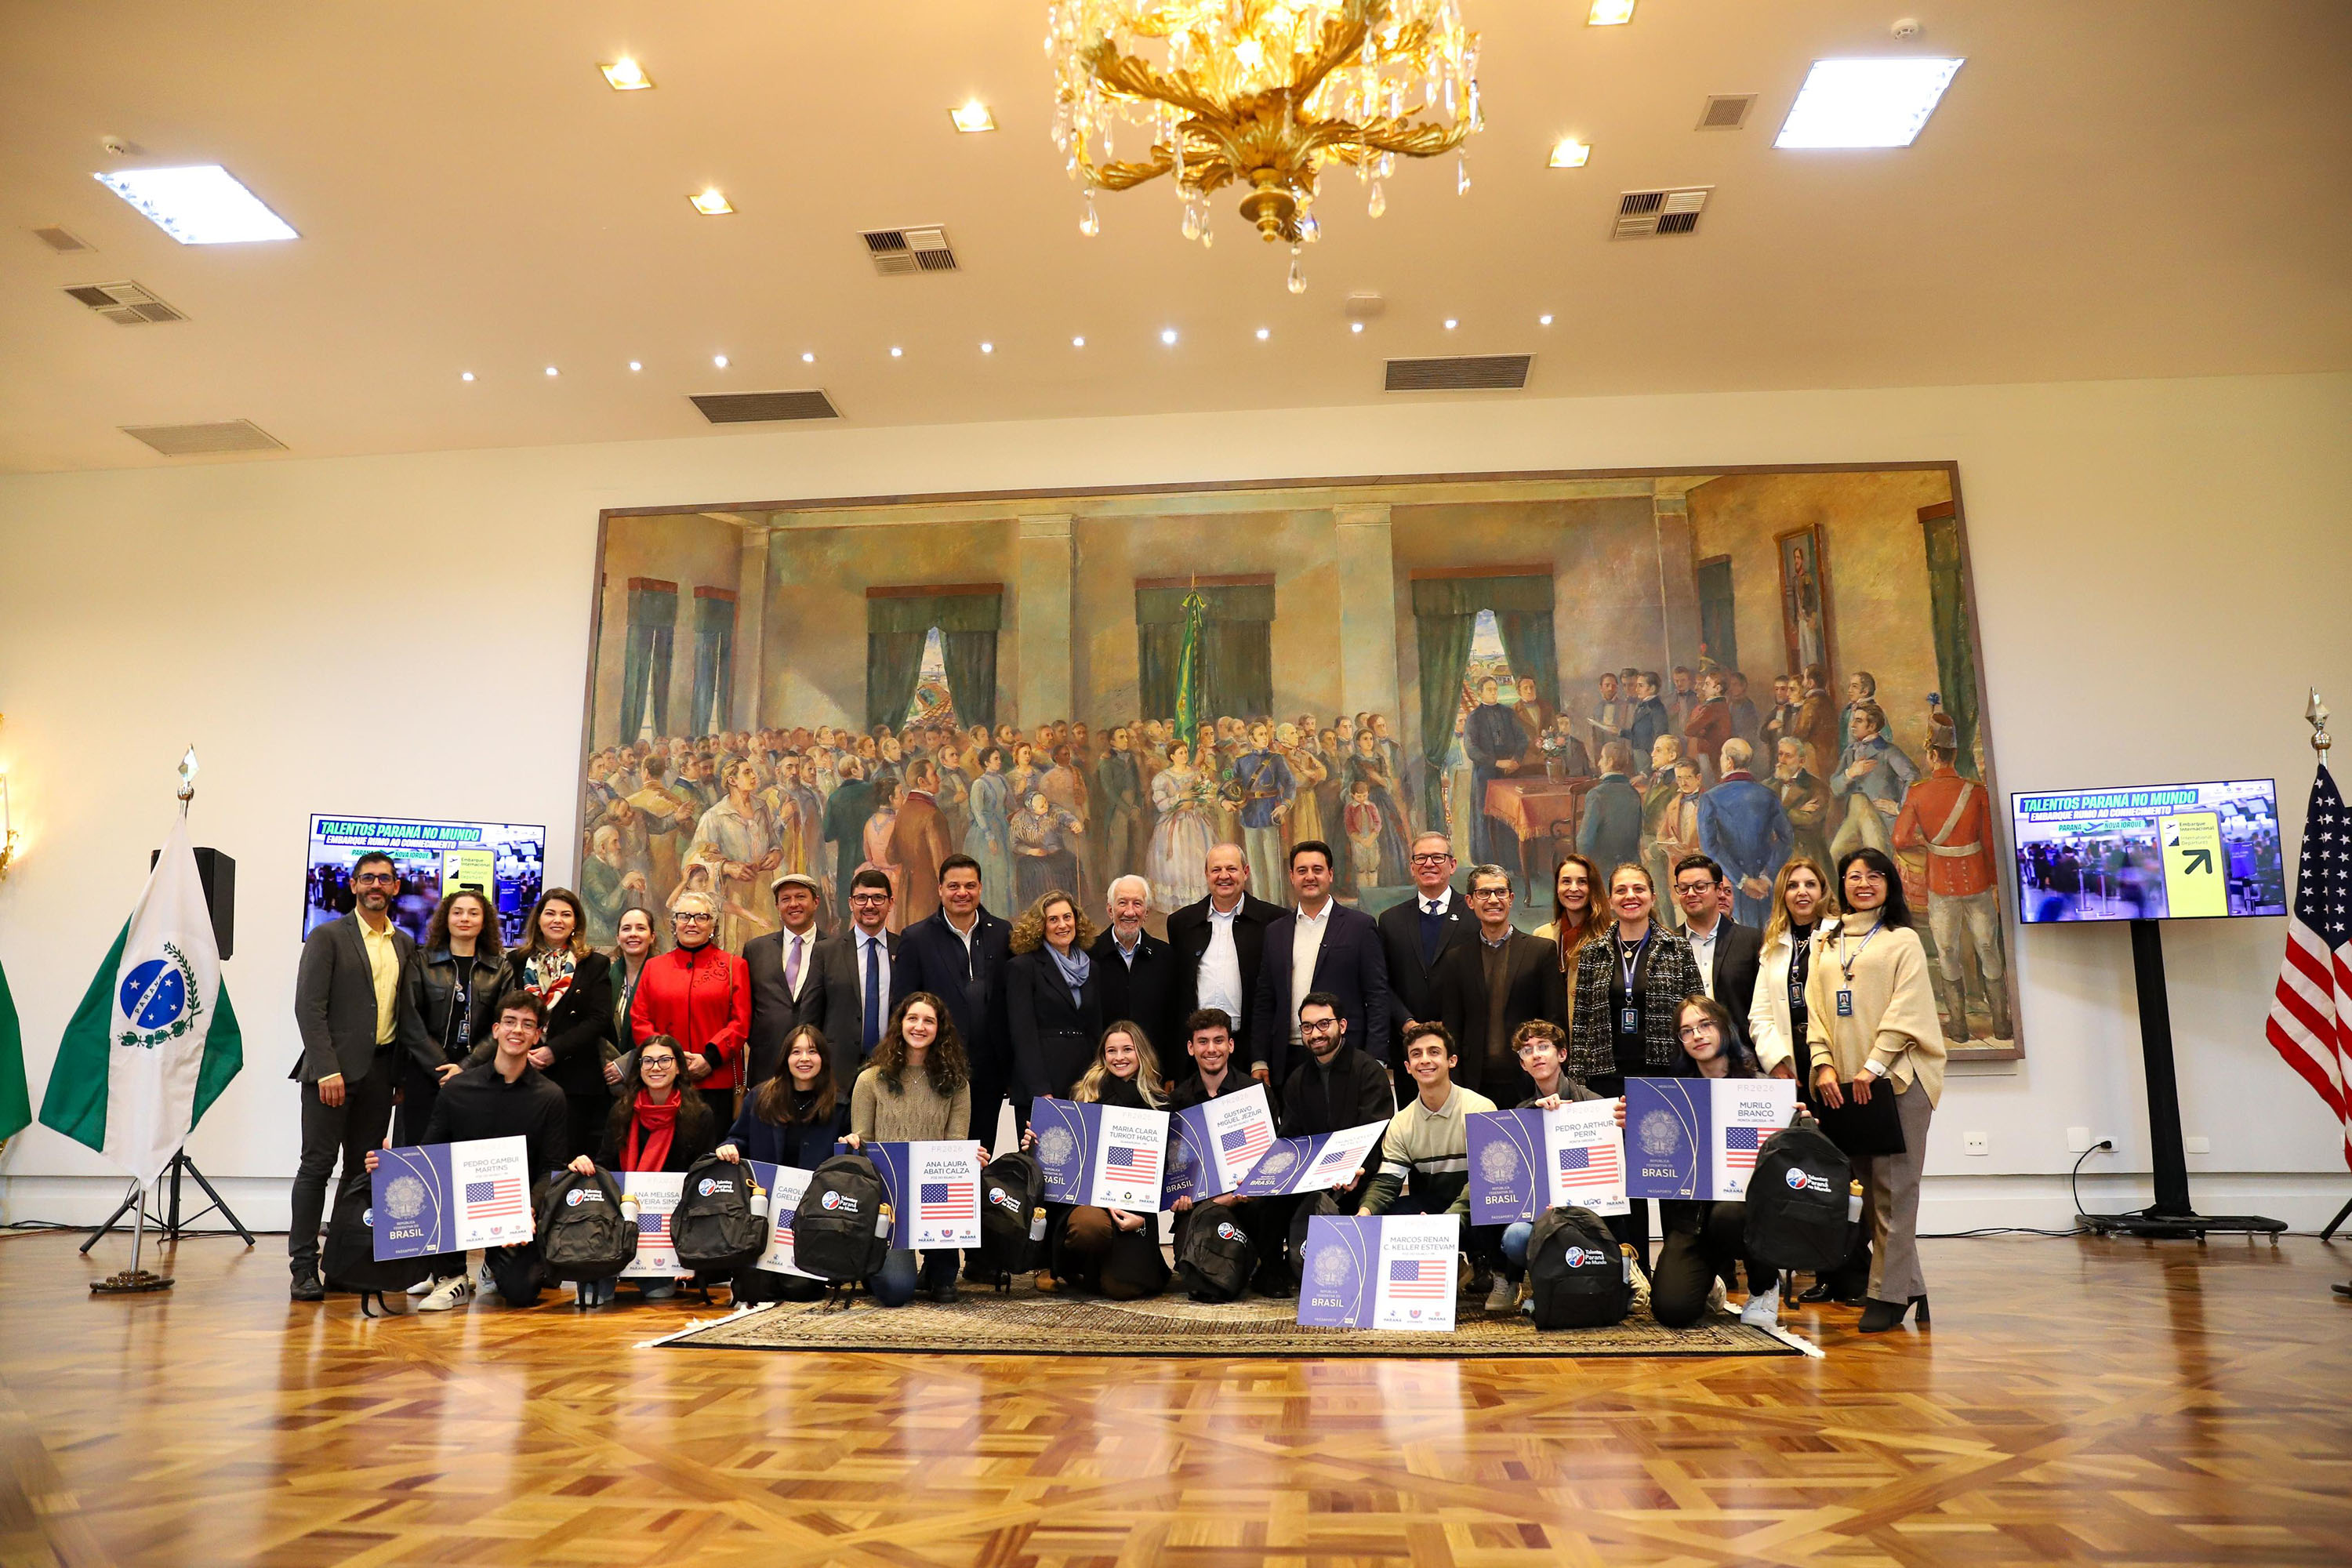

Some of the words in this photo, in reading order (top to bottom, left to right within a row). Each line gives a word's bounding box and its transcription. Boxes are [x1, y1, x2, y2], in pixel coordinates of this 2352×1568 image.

[2023, 798, 2080, 812] TALENTOS
[2082, 793, 2130, 809] PARANÁ
[2131, 794, 2149, 807] NO
[2150, 791, 2196, 806] MUNDO
[2030, 811, 2074, 821] EMBARQUE
[2074, 810, 2097, 819] RUMO
[2097, 809, 2109, 818] AO
[2110, 806, 2171, 818] CONHECIMENTO
[321, 822, 376, 836] TALENTOS
[376, 825, 422, 839] PARANÁ
[422, 827, 438, 840] NO
[439, 829, 480, 841] MUNDO
[326, 835, 368, 846] EMBARQUE
[367, 837, 390, 847] RUMO
[390, 838, 400, 848] AO
[401, 839, 457, 849] CONHECIMENTO
[1224, 1105, 1253, 1119] GUSTAVO
[1218, 1116, 1240, 1127] MIGUEL
[1240, 1109, 1262, 1122] JEZIUR
[1555, 1123, 1581, 1132] PEDRO
[1583, 1120, 1614, 1130] ARTHUR
[1109, 1131, 1135, 1140] TURKOT
[463, 1159, 488, 1167] PEDRO
[475, 1164, 508, 1173] MARTINS
[1642, 1168, 1679, 1178] BRASIL
[1044, 1175, 1065, 1185] RASIL
[1807, 1178, 1828, 1187] Paraná
[778, 1185, 804, 1195] CAROLI
[1166, 1180, 1194, 1193] BRASIL
[1485, 1194, 1519, 1204] BRASIL
[390, 1228, 424, 1240] BRASIL
[1312, 1298, 1344, 1307] BRASIL
